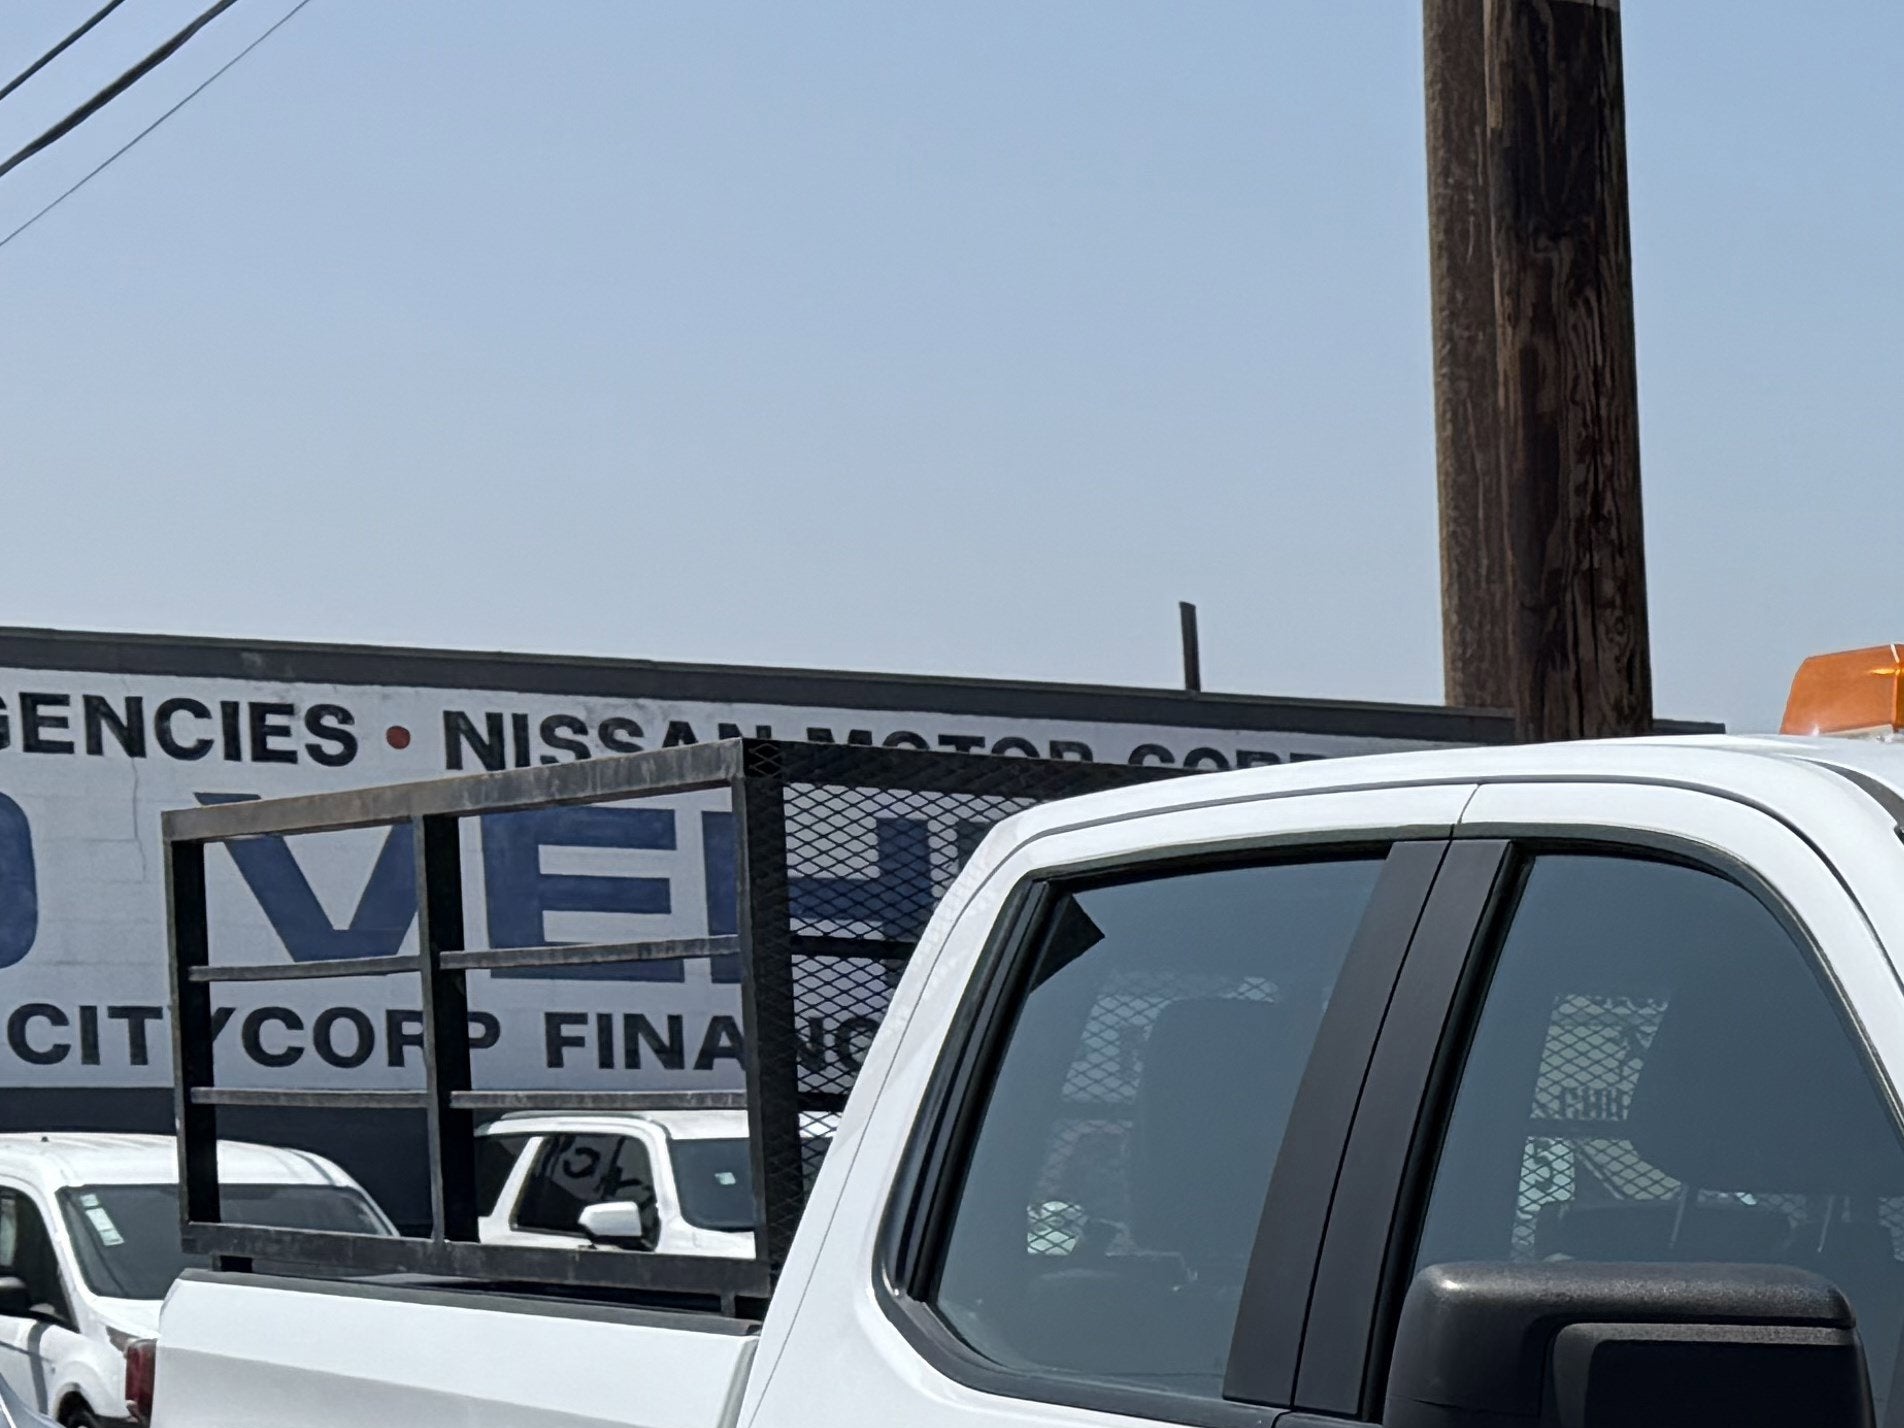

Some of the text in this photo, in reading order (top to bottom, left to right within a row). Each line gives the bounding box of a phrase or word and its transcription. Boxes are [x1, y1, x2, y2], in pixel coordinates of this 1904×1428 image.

[0, 690, 358, 767] ENCIES
[443, 710, 772, 771] NISS
[7, 1002, 501, 1069] CITCORP
